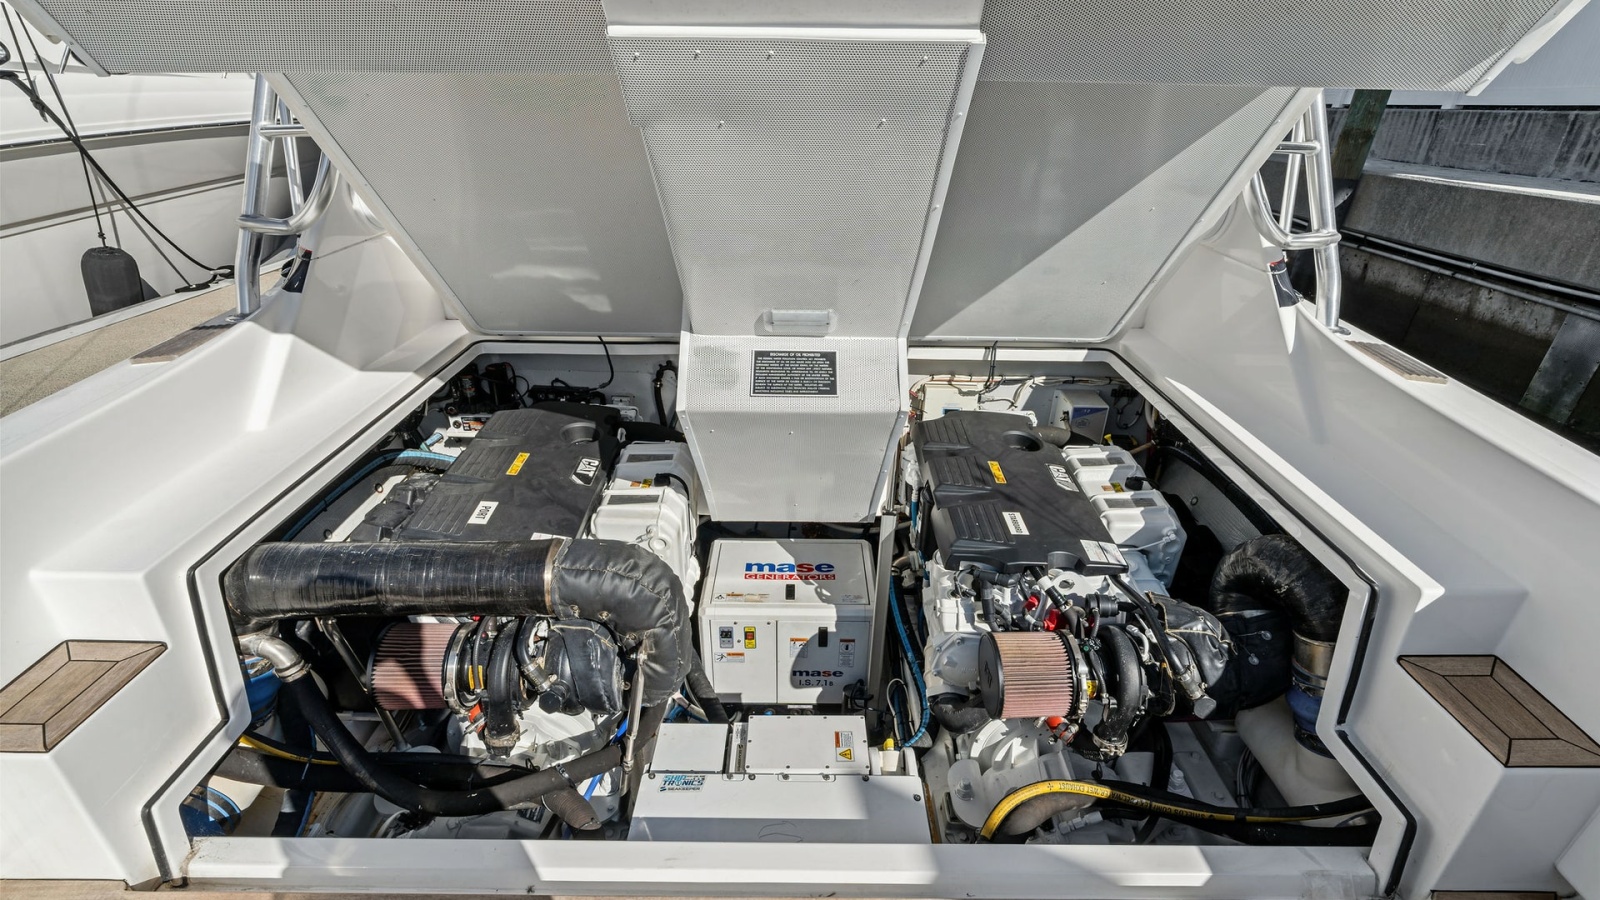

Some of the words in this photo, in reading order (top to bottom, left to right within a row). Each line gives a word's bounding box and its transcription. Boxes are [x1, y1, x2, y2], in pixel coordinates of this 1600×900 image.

[576, 458, 599, 478] CAT
[1049, 466, 1071, 483] CAT
[475, 505, 492, 520] PORT
[1008, 513, 1023, 533] STARBOARD
[745, 563, 834, 573] mase
[1058, 782, 1084, 792] EXHAUST
